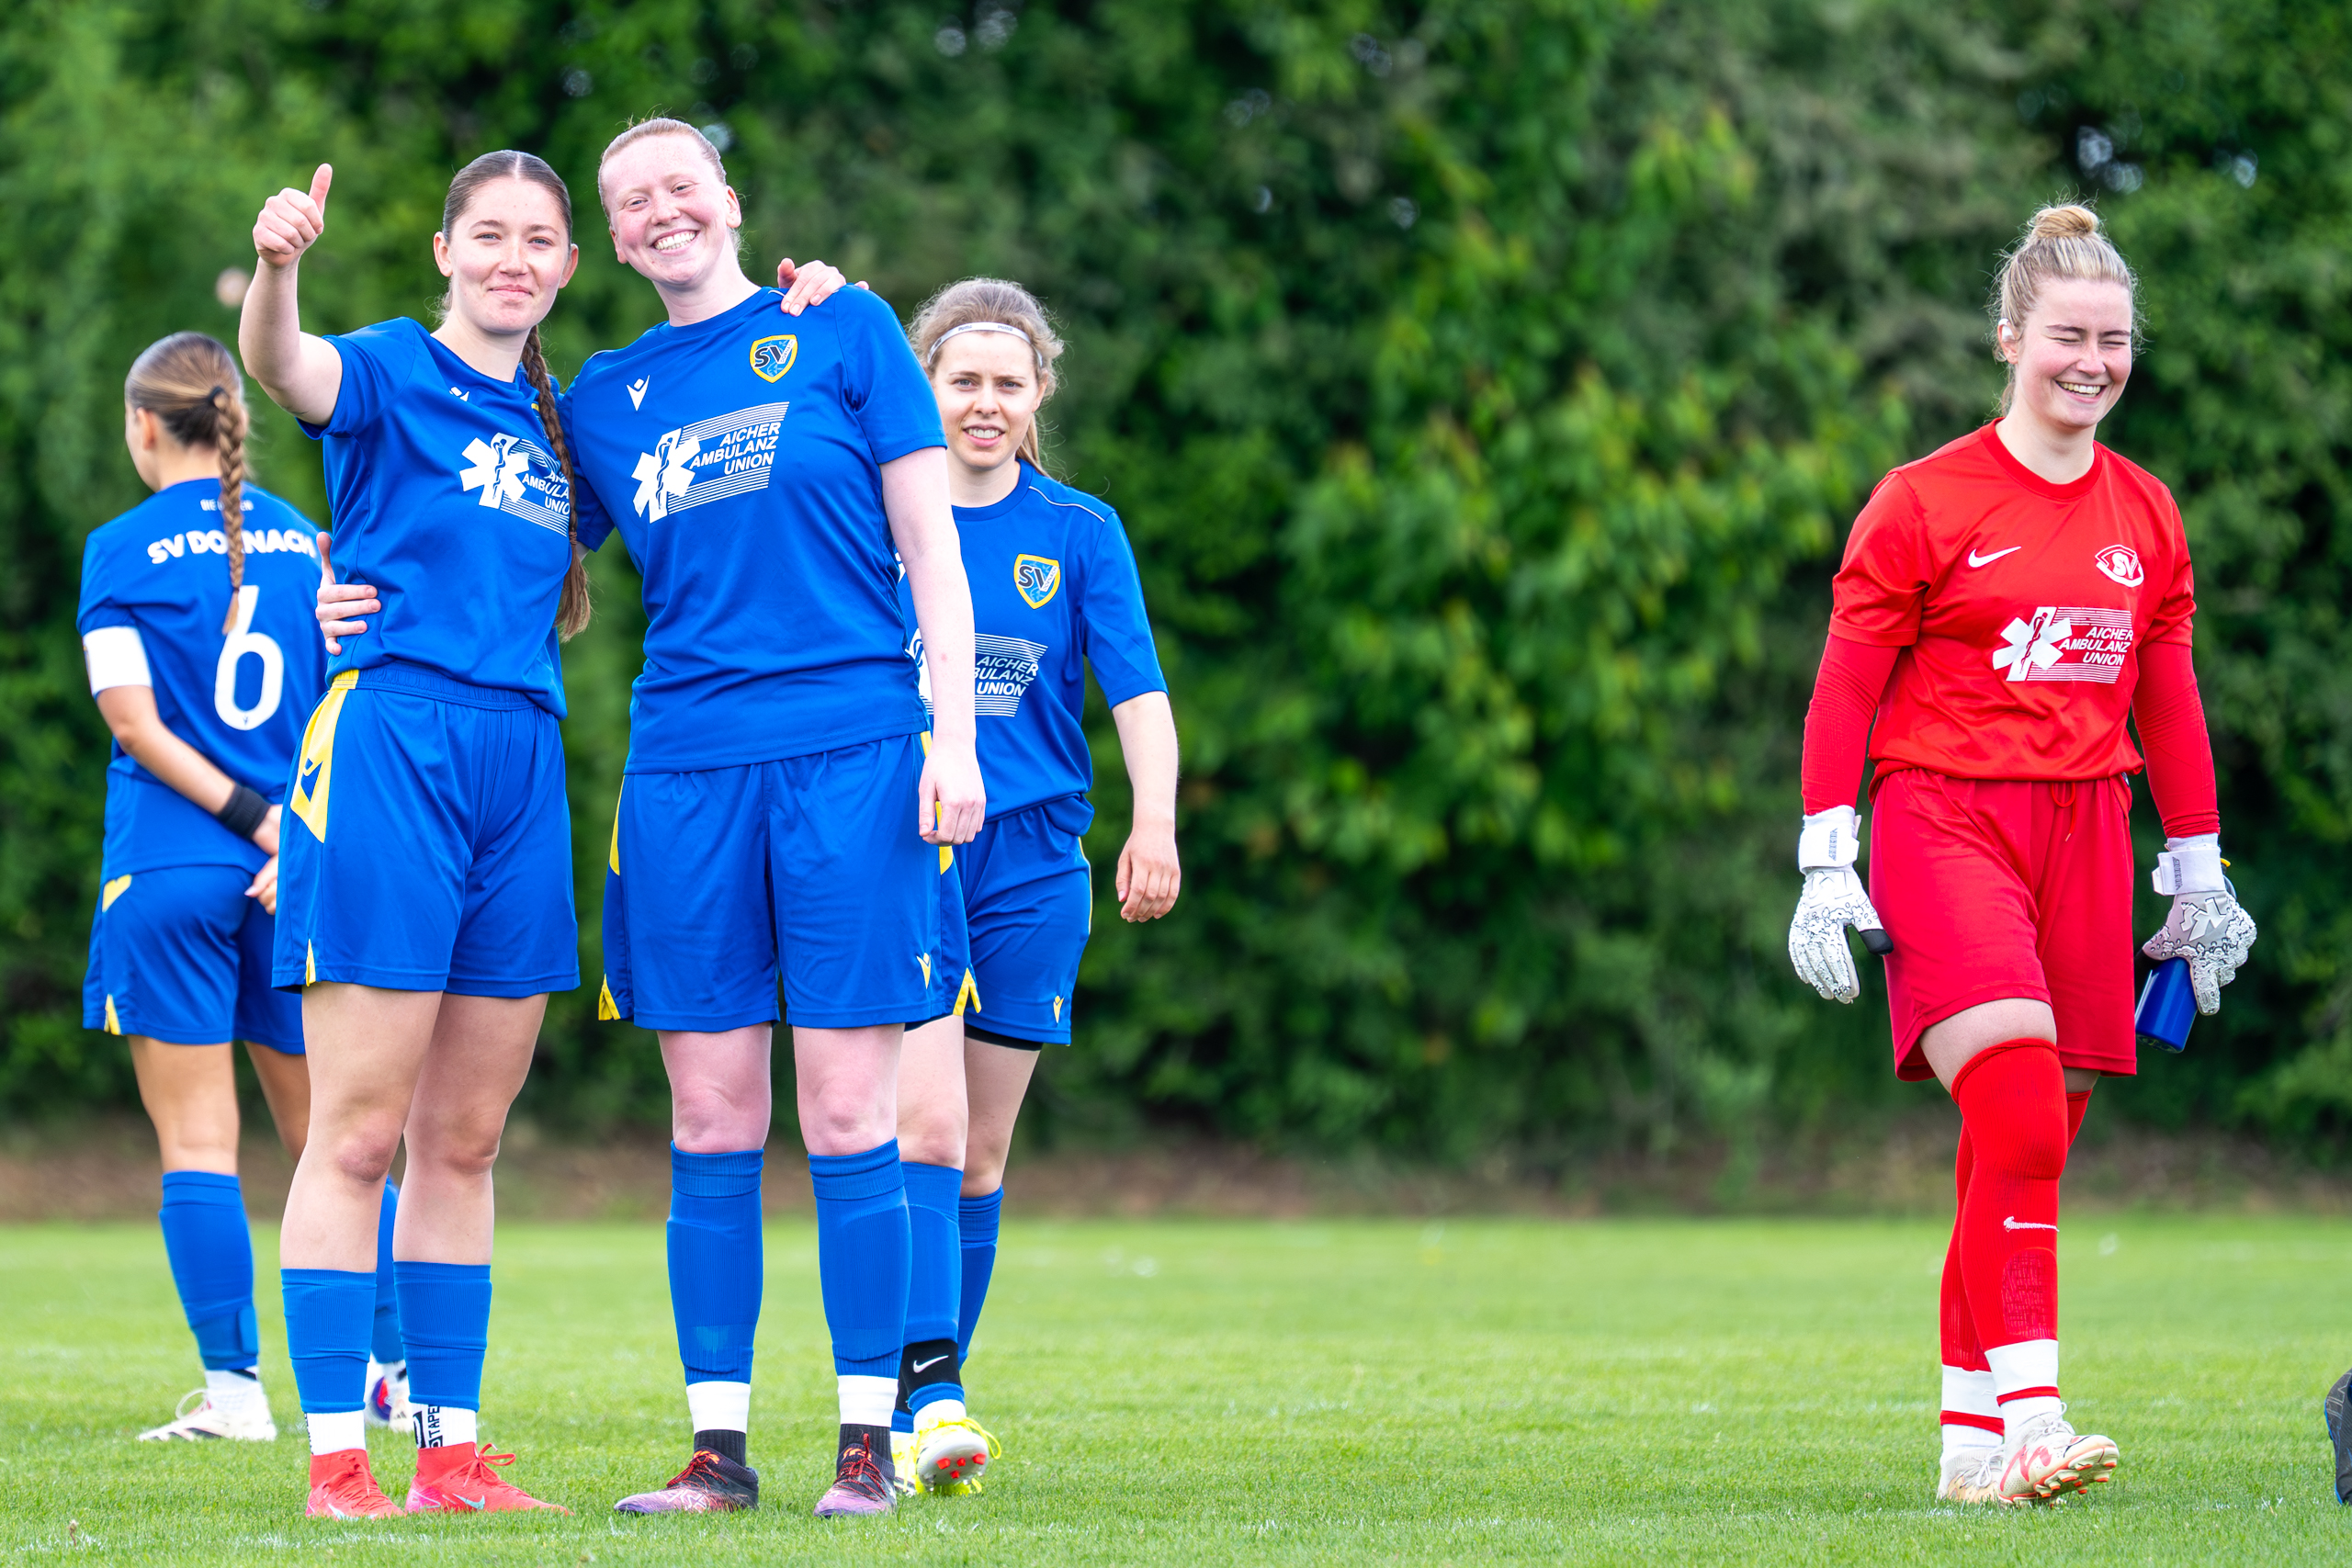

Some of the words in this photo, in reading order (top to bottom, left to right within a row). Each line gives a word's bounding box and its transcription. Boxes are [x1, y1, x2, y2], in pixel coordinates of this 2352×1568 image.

[719, 422, 782, 447] AICHER
[689, 435, 779, 469] AMBULANZ
[724, 451, 775, 475] UNION
[522, 473, 570, 501] AMBULA
[545, 496, 571, 515] UNIO
[147, 533, 185, 564] SV
[186, 529, 317, 558] DONACH
[2111, 552, 2138, 580] SV
[2086, 626, 2134, 641] AICHER
[2058, 637, 2132, 653] AMBULANZ
[214, 584, 284, 731] 6
[976, 656, 1039, 676] AICHER
[2082, 651, 2125, 666] UNION
[974, 667, 1035, 686] BULANZ
[977, 682, 1027, 696] UNION
